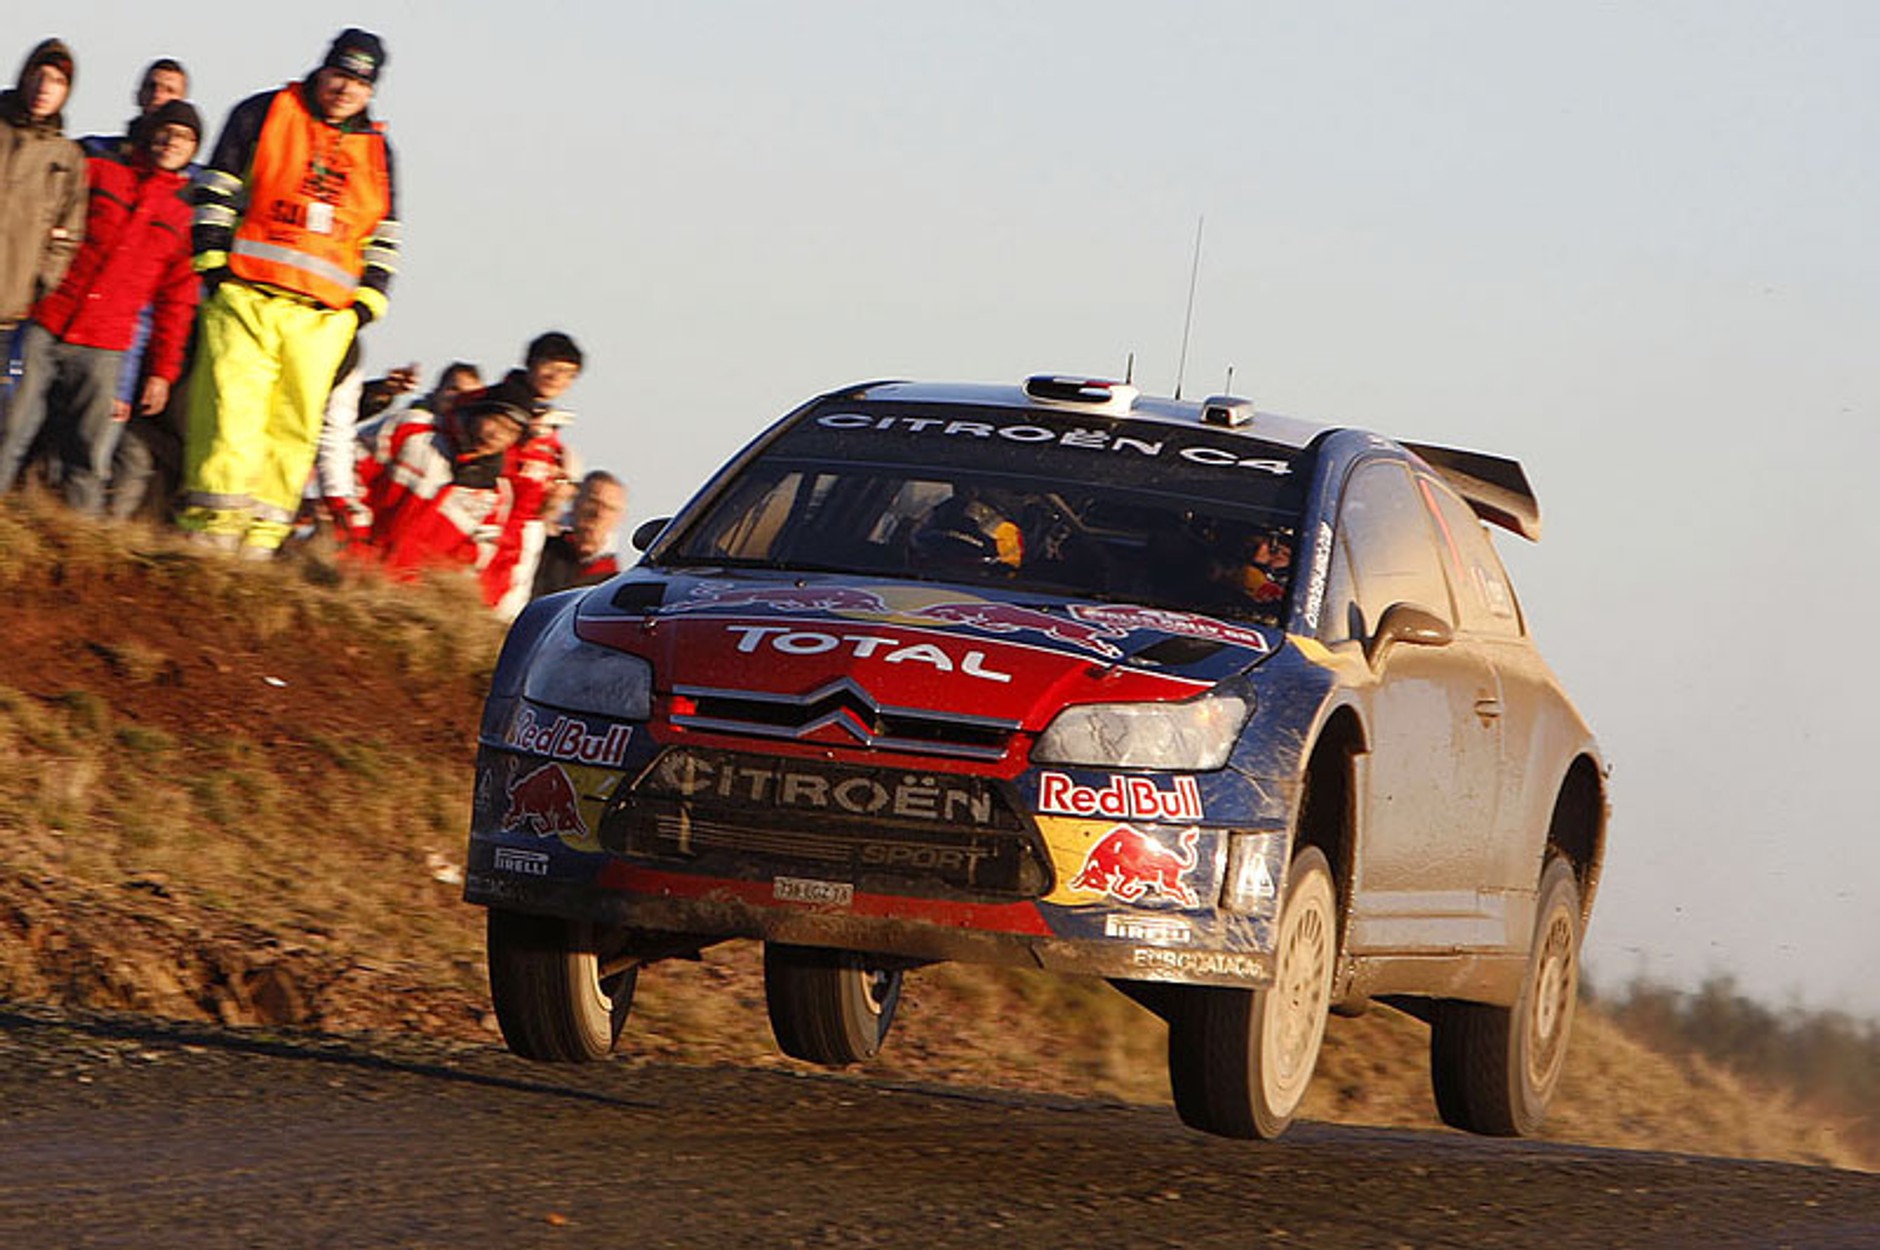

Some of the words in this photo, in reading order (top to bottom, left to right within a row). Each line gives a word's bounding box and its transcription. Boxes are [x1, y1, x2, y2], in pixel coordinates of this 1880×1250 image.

[817, 412, 1164, 456] CITROËN
[1179, 447, 1293, 476] C4
[727, 624, 1012, 683] TOTAL
[505, 709, 566, 755] Red
[552, 719, 633, 767] Bull
[657, 752, 991, 823] CITROËN
[1040, 772, 1128, 816] Red
[1129, 777, 1202, 819] Bull
[494, 847, 549, 875] PIRELLI
[860, 844, 988, 872] SPORT
